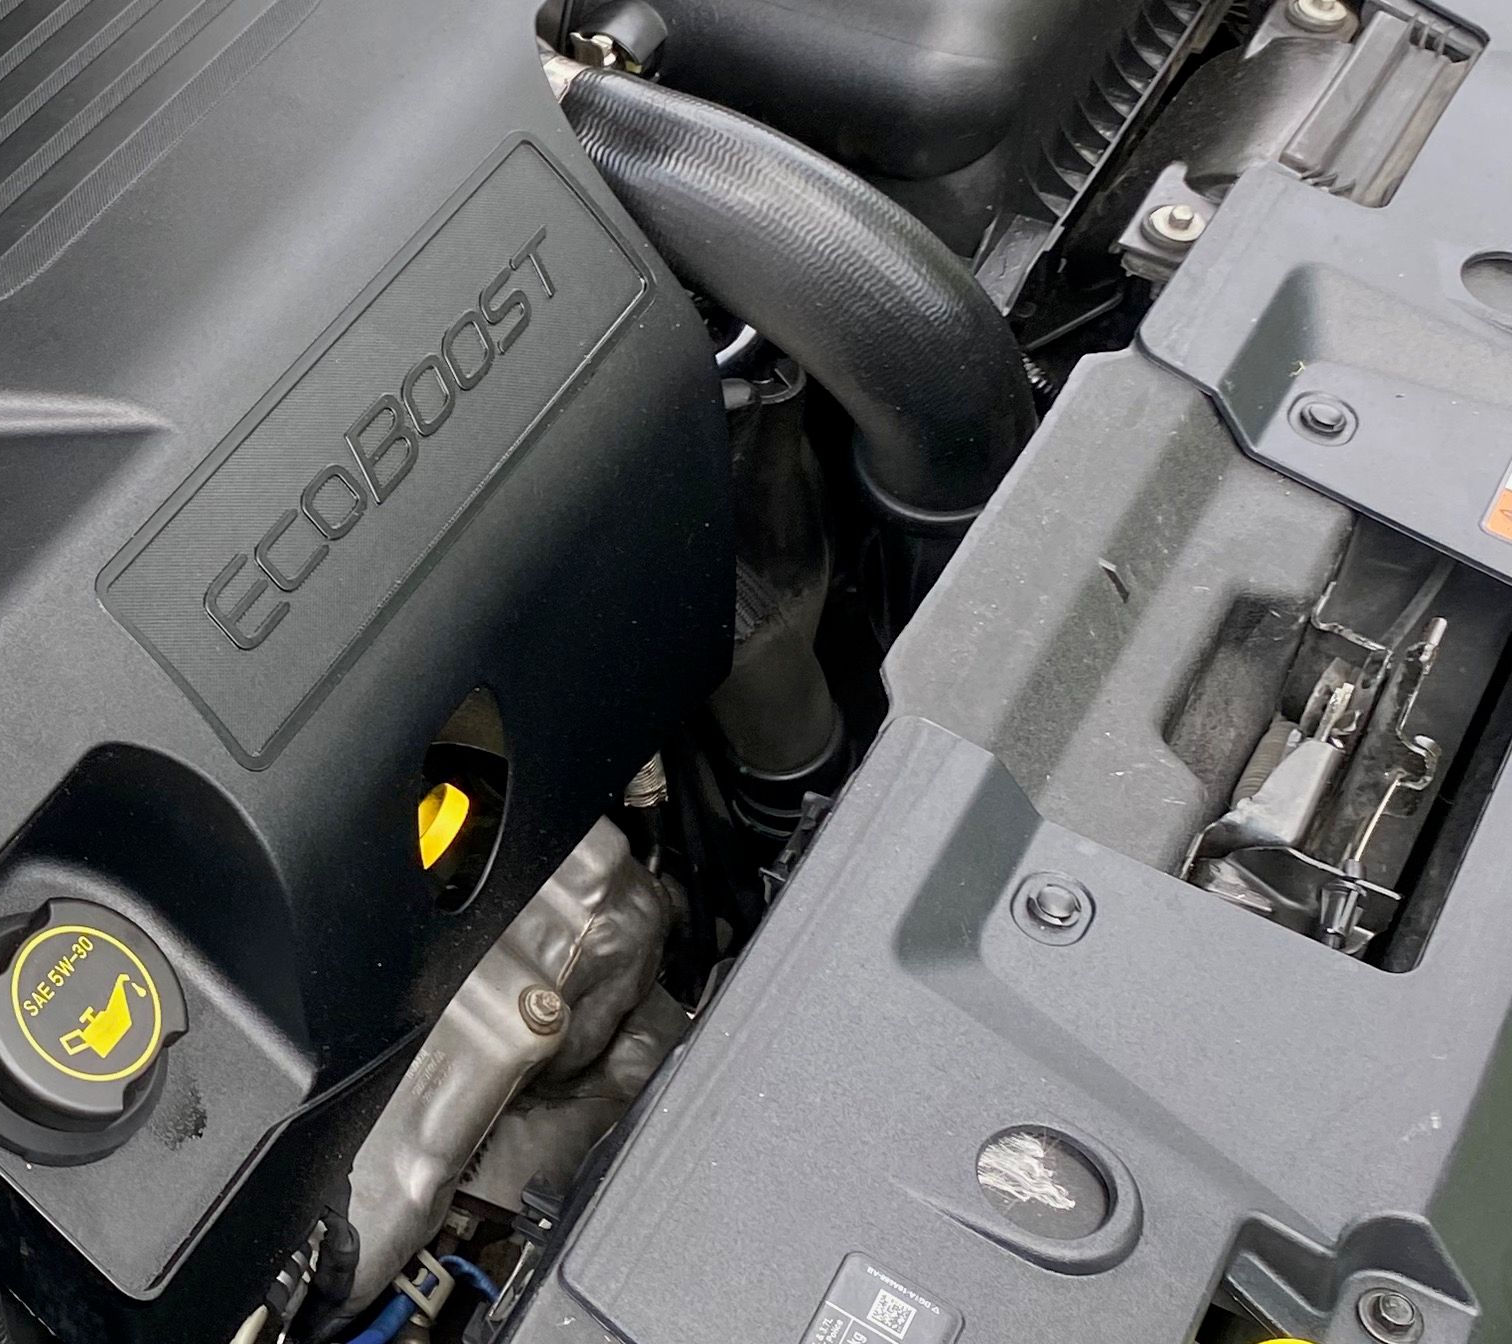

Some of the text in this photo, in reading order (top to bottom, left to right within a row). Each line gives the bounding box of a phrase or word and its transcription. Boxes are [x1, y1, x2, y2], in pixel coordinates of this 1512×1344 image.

[203, 225, 555, 651] ECOBOOST
[23, 935, 94, 1018] SAE 5W-30
[822, 1317, 834, 1336] 3.7L
[827, 1319, 844, 1344] Police
